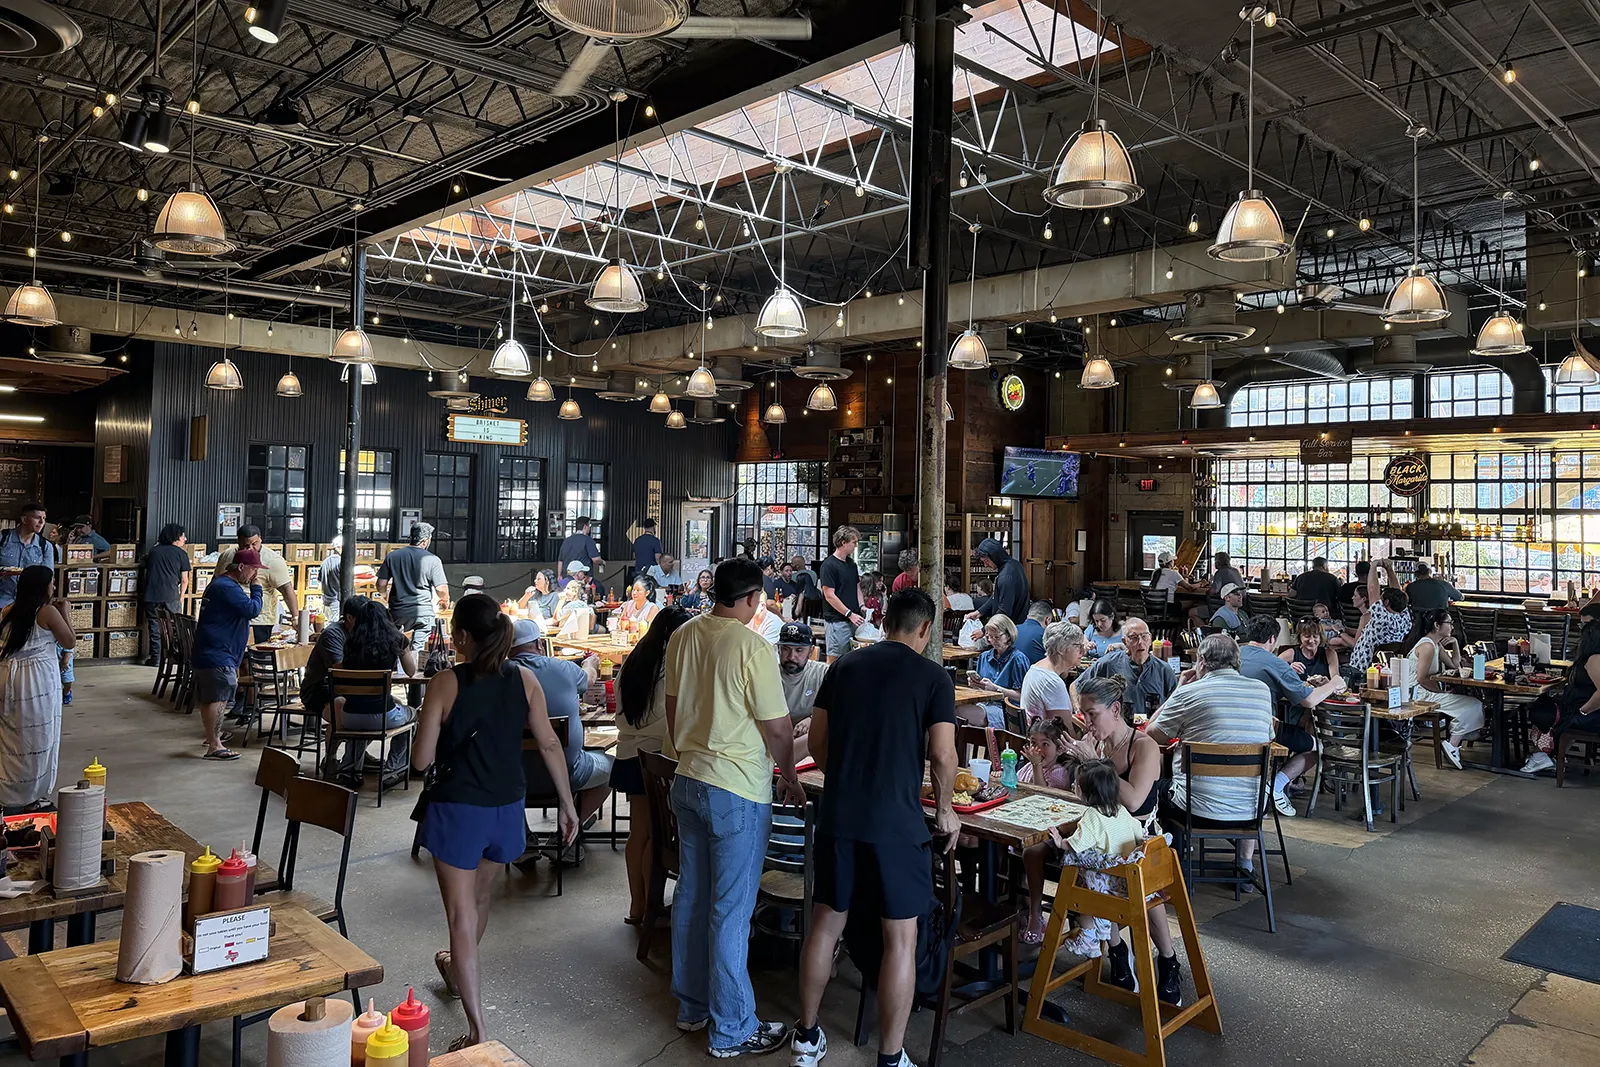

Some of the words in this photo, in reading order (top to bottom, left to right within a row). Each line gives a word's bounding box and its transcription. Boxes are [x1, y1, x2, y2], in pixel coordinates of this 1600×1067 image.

[468, 396, 507, 413] Shiner
[1301, 438, 1318, 448] Full
[1319, 439, 1350, 448] Service
[1317, 448, 1334, 458] Bar
[1390, 464, 1424, 476] BLACK
[1141, 479, 1154, 490] EXIT
[1385, 472, 1428, 487] Margarita
[222, 914, 246, 924] PLEASE
